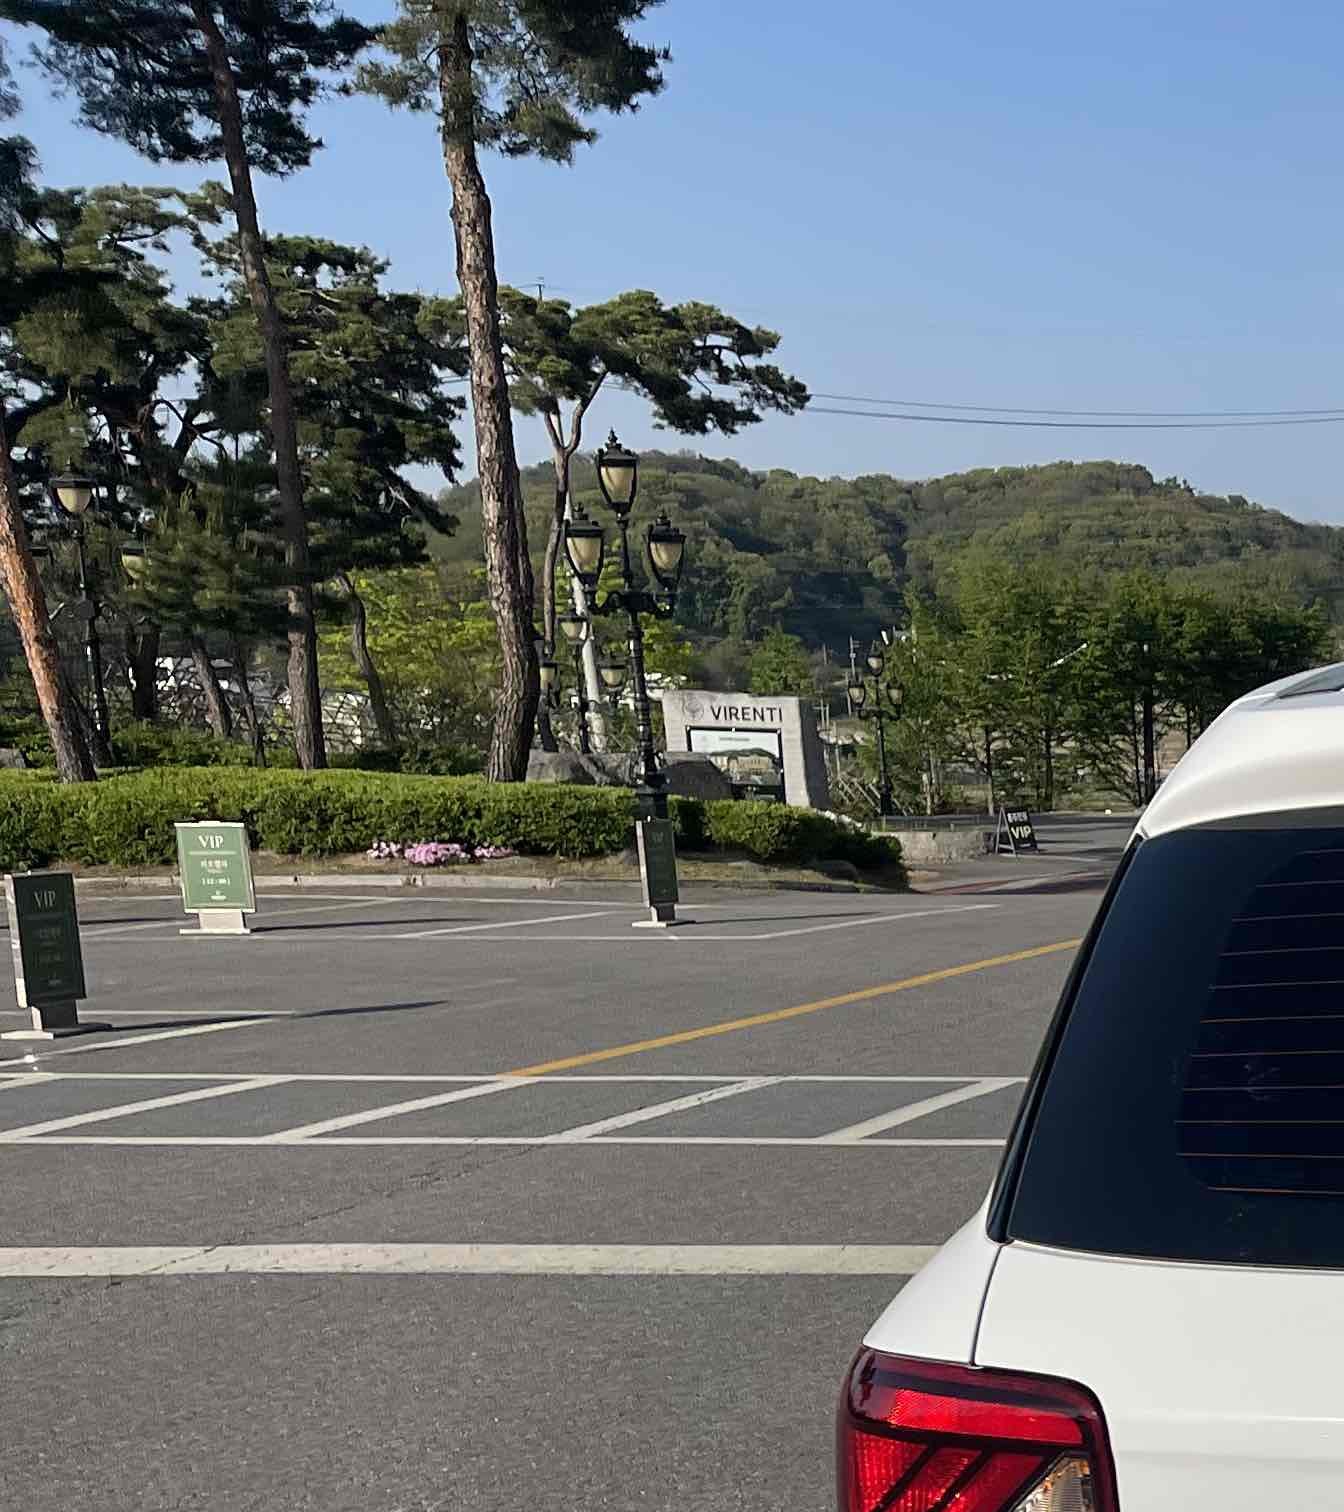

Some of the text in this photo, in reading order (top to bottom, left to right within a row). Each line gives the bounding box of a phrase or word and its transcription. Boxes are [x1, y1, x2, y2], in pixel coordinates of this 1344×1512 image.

[710, 705, 783, 723] VIRENTI
[1011, 825, 1031, 839] VIP
[198, 835, 224, 849] VIP
[34, 890, 56, 909] VIP
